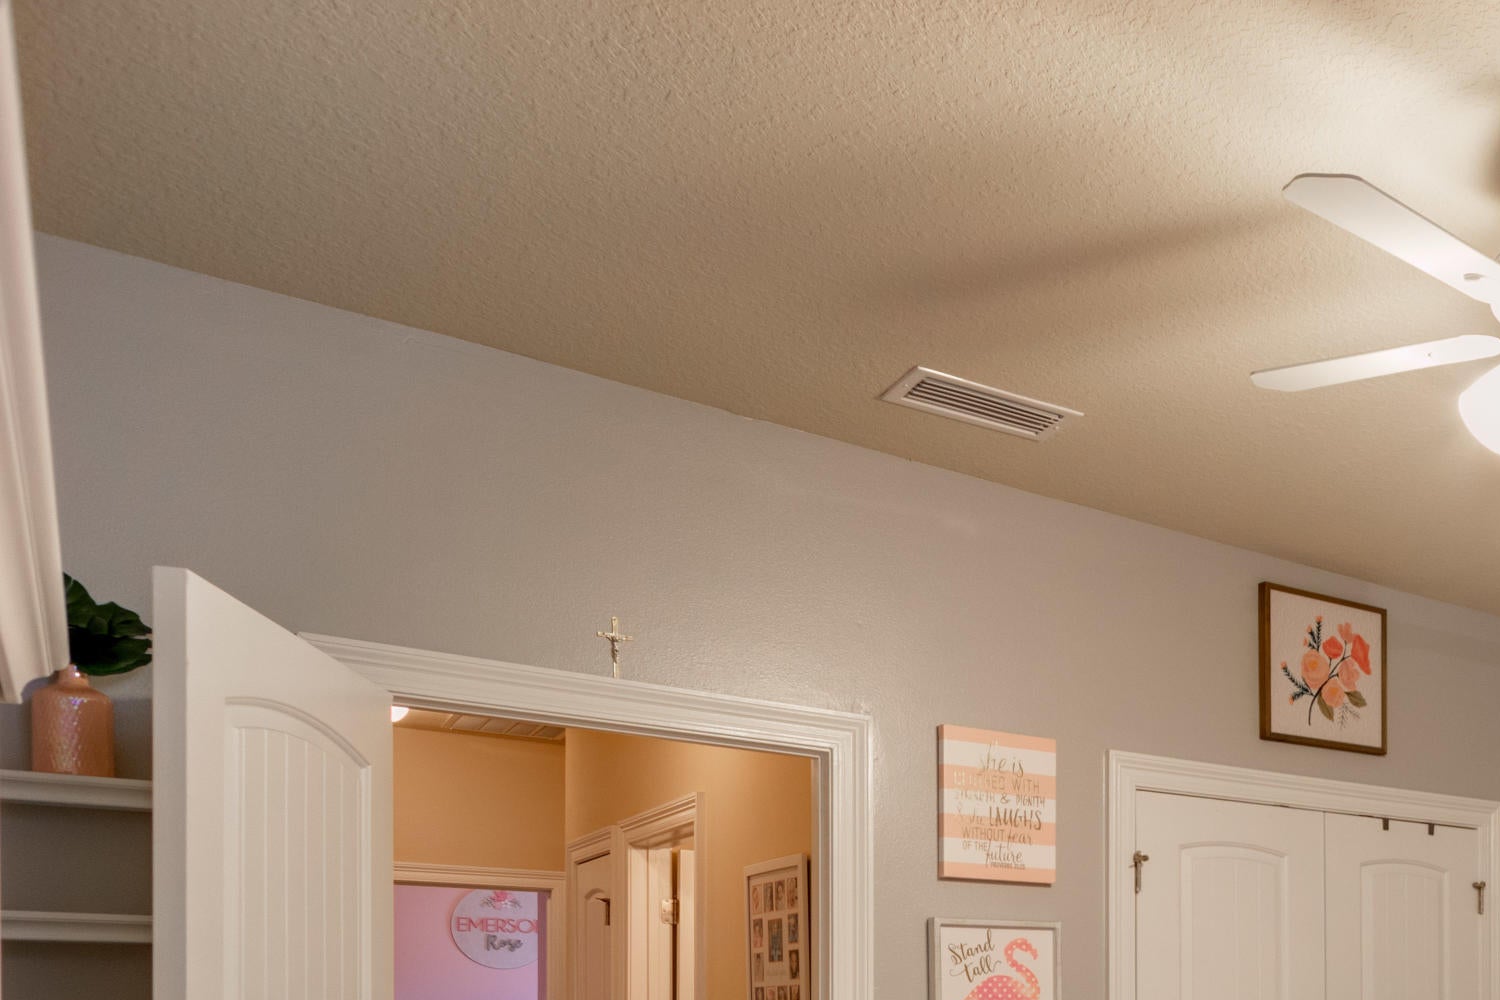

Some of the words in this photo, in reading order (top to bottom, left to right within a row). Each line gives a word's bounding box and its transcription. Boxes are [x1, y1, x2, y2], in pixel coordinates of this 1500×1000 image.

[1012, 756, 1024, 777] is
[1012, 777, 1040, 794] WITH
[988, 805, 1042, 831] LAUGHS
[962, 826, 1005, 842] WITHOUT
[486, 934, 523, 951] Rose
[948, 928, 995, 965] Stand
[950, 954, 1002, 983] tall
